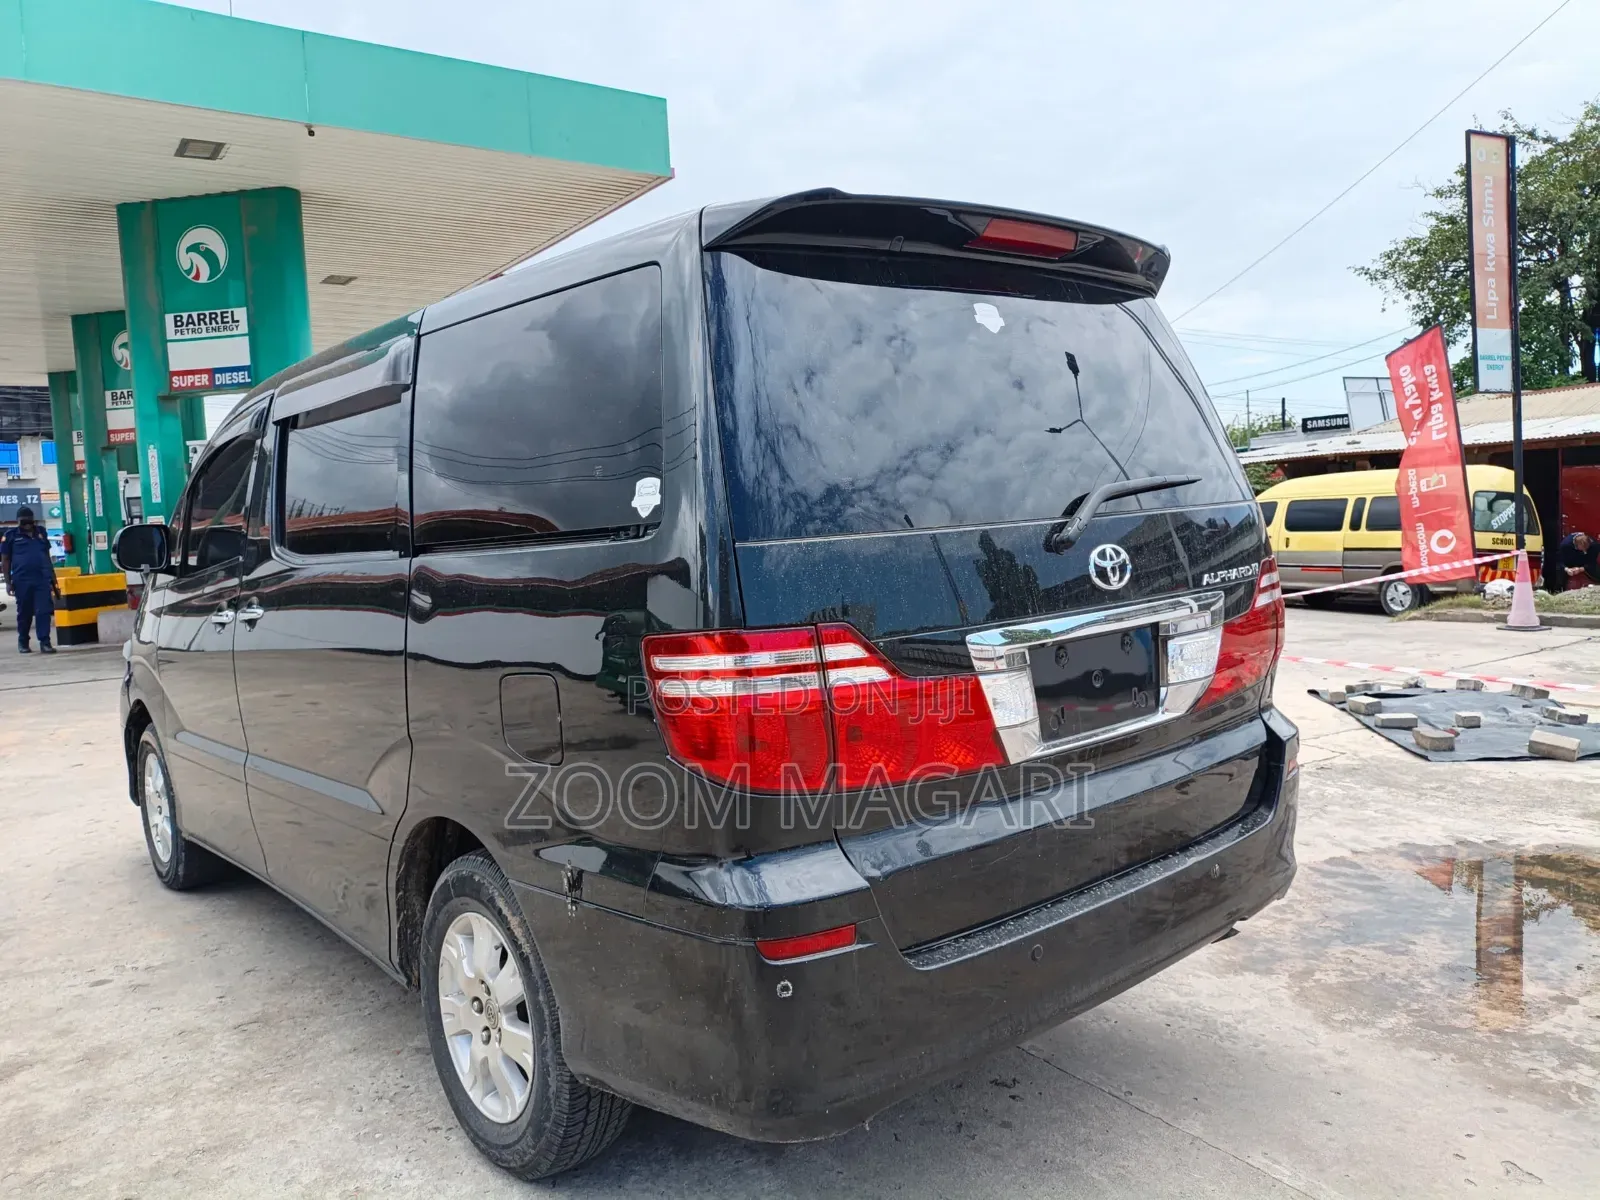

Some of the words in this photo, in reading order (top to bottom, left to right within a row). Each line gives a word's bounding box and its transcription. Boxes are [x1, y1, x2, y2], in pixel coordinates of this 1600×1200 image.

[1483, 175, 1495, 228] Simu
[1485, 233, 1496, 272] kwa
[1486, 278, 1499, 320] Lipa
[173, 310, 240, 328] BARREL
[174, 327, 203, 336] PETRO
[206, 324, 240, 334] ENERGY
[172, 374, 209, 388] SUPER
[215, 371, 251, 385] DIESEL
[1307, 416, 1349, 429] SAMSUNG
[110, 432, 135, 442] SUPER
[1491, 537, 1514, 546] SCHOOL
